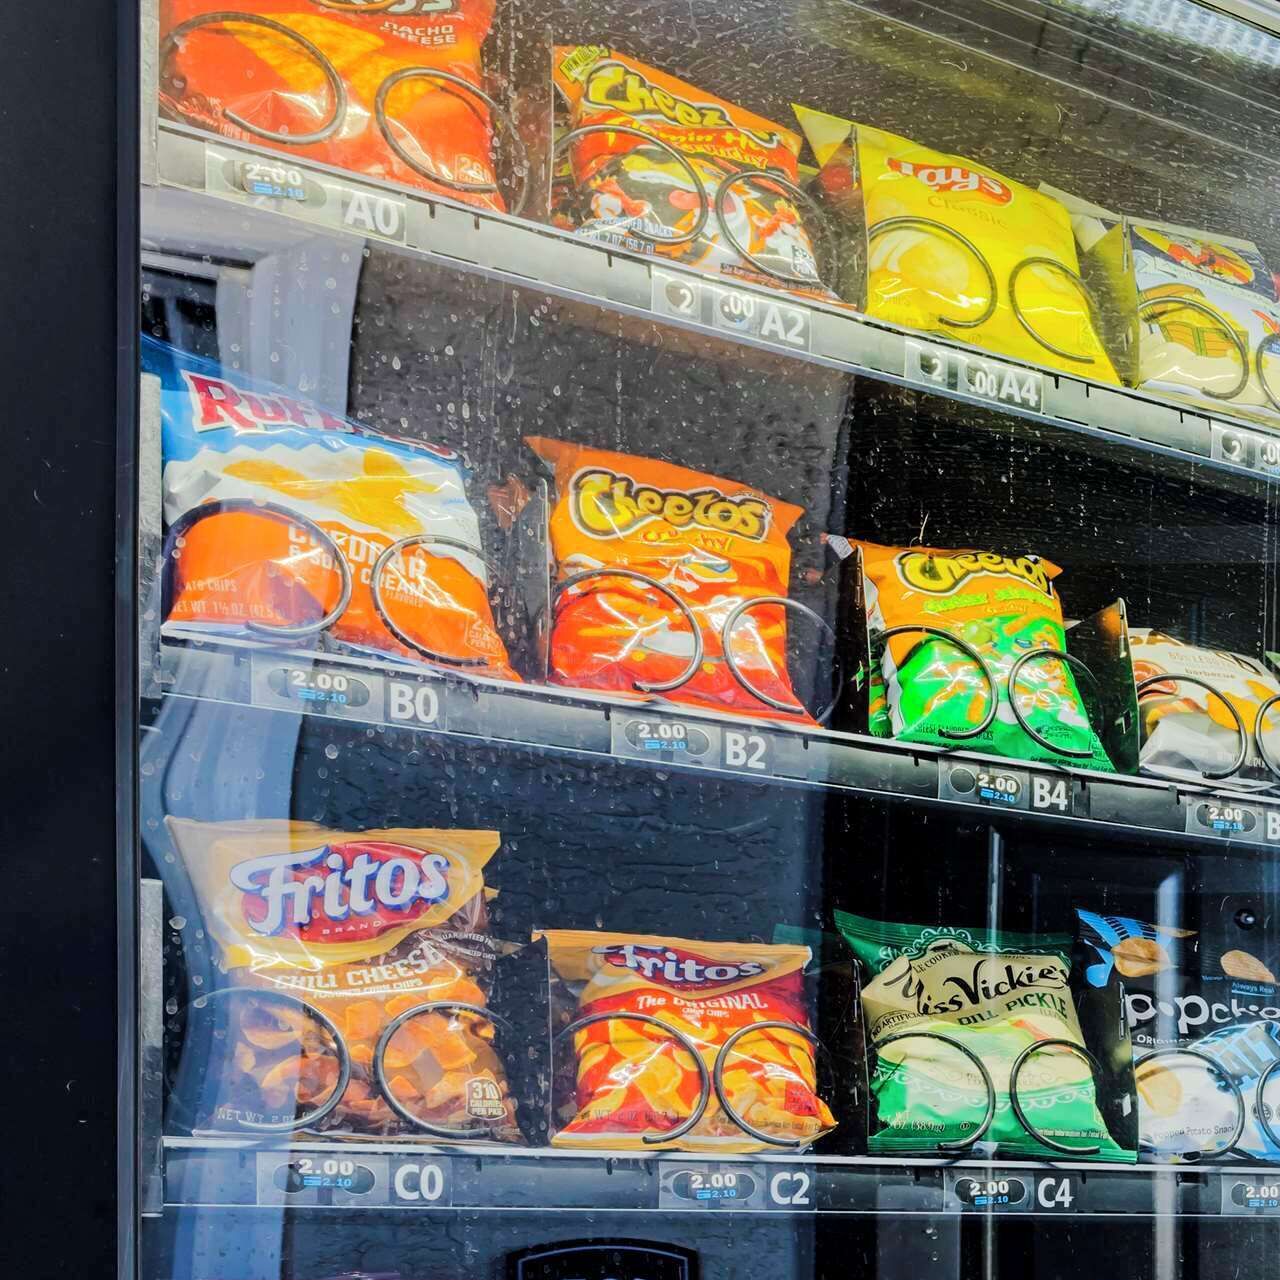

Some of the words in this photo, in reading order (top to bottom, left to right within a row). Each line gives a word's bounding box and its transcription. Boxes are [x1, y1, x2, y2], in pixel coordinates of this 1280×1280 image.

[345, 192, 400, 235] A0
[762, 305, 804, 345] A2
[1000, 372, 1037, 406] A4
[575, 470, 769, 538] Cheetos
[389, 683, 438, 723] B0
[726, 732, 766, 768] B2
[1033, 778, 1068, 811] B4
[231, 845, 450, 936] Fritos
[322, 919, 383, 935] BRAND
[637, 996, 666, 1009] The
[1006, 992, 1067, 1019] PICKLE
[395, 1164, 443, 1200] C0
[770, 1172, 809, 1205] C2
[1038, 1178, 1073, 1207] C4
